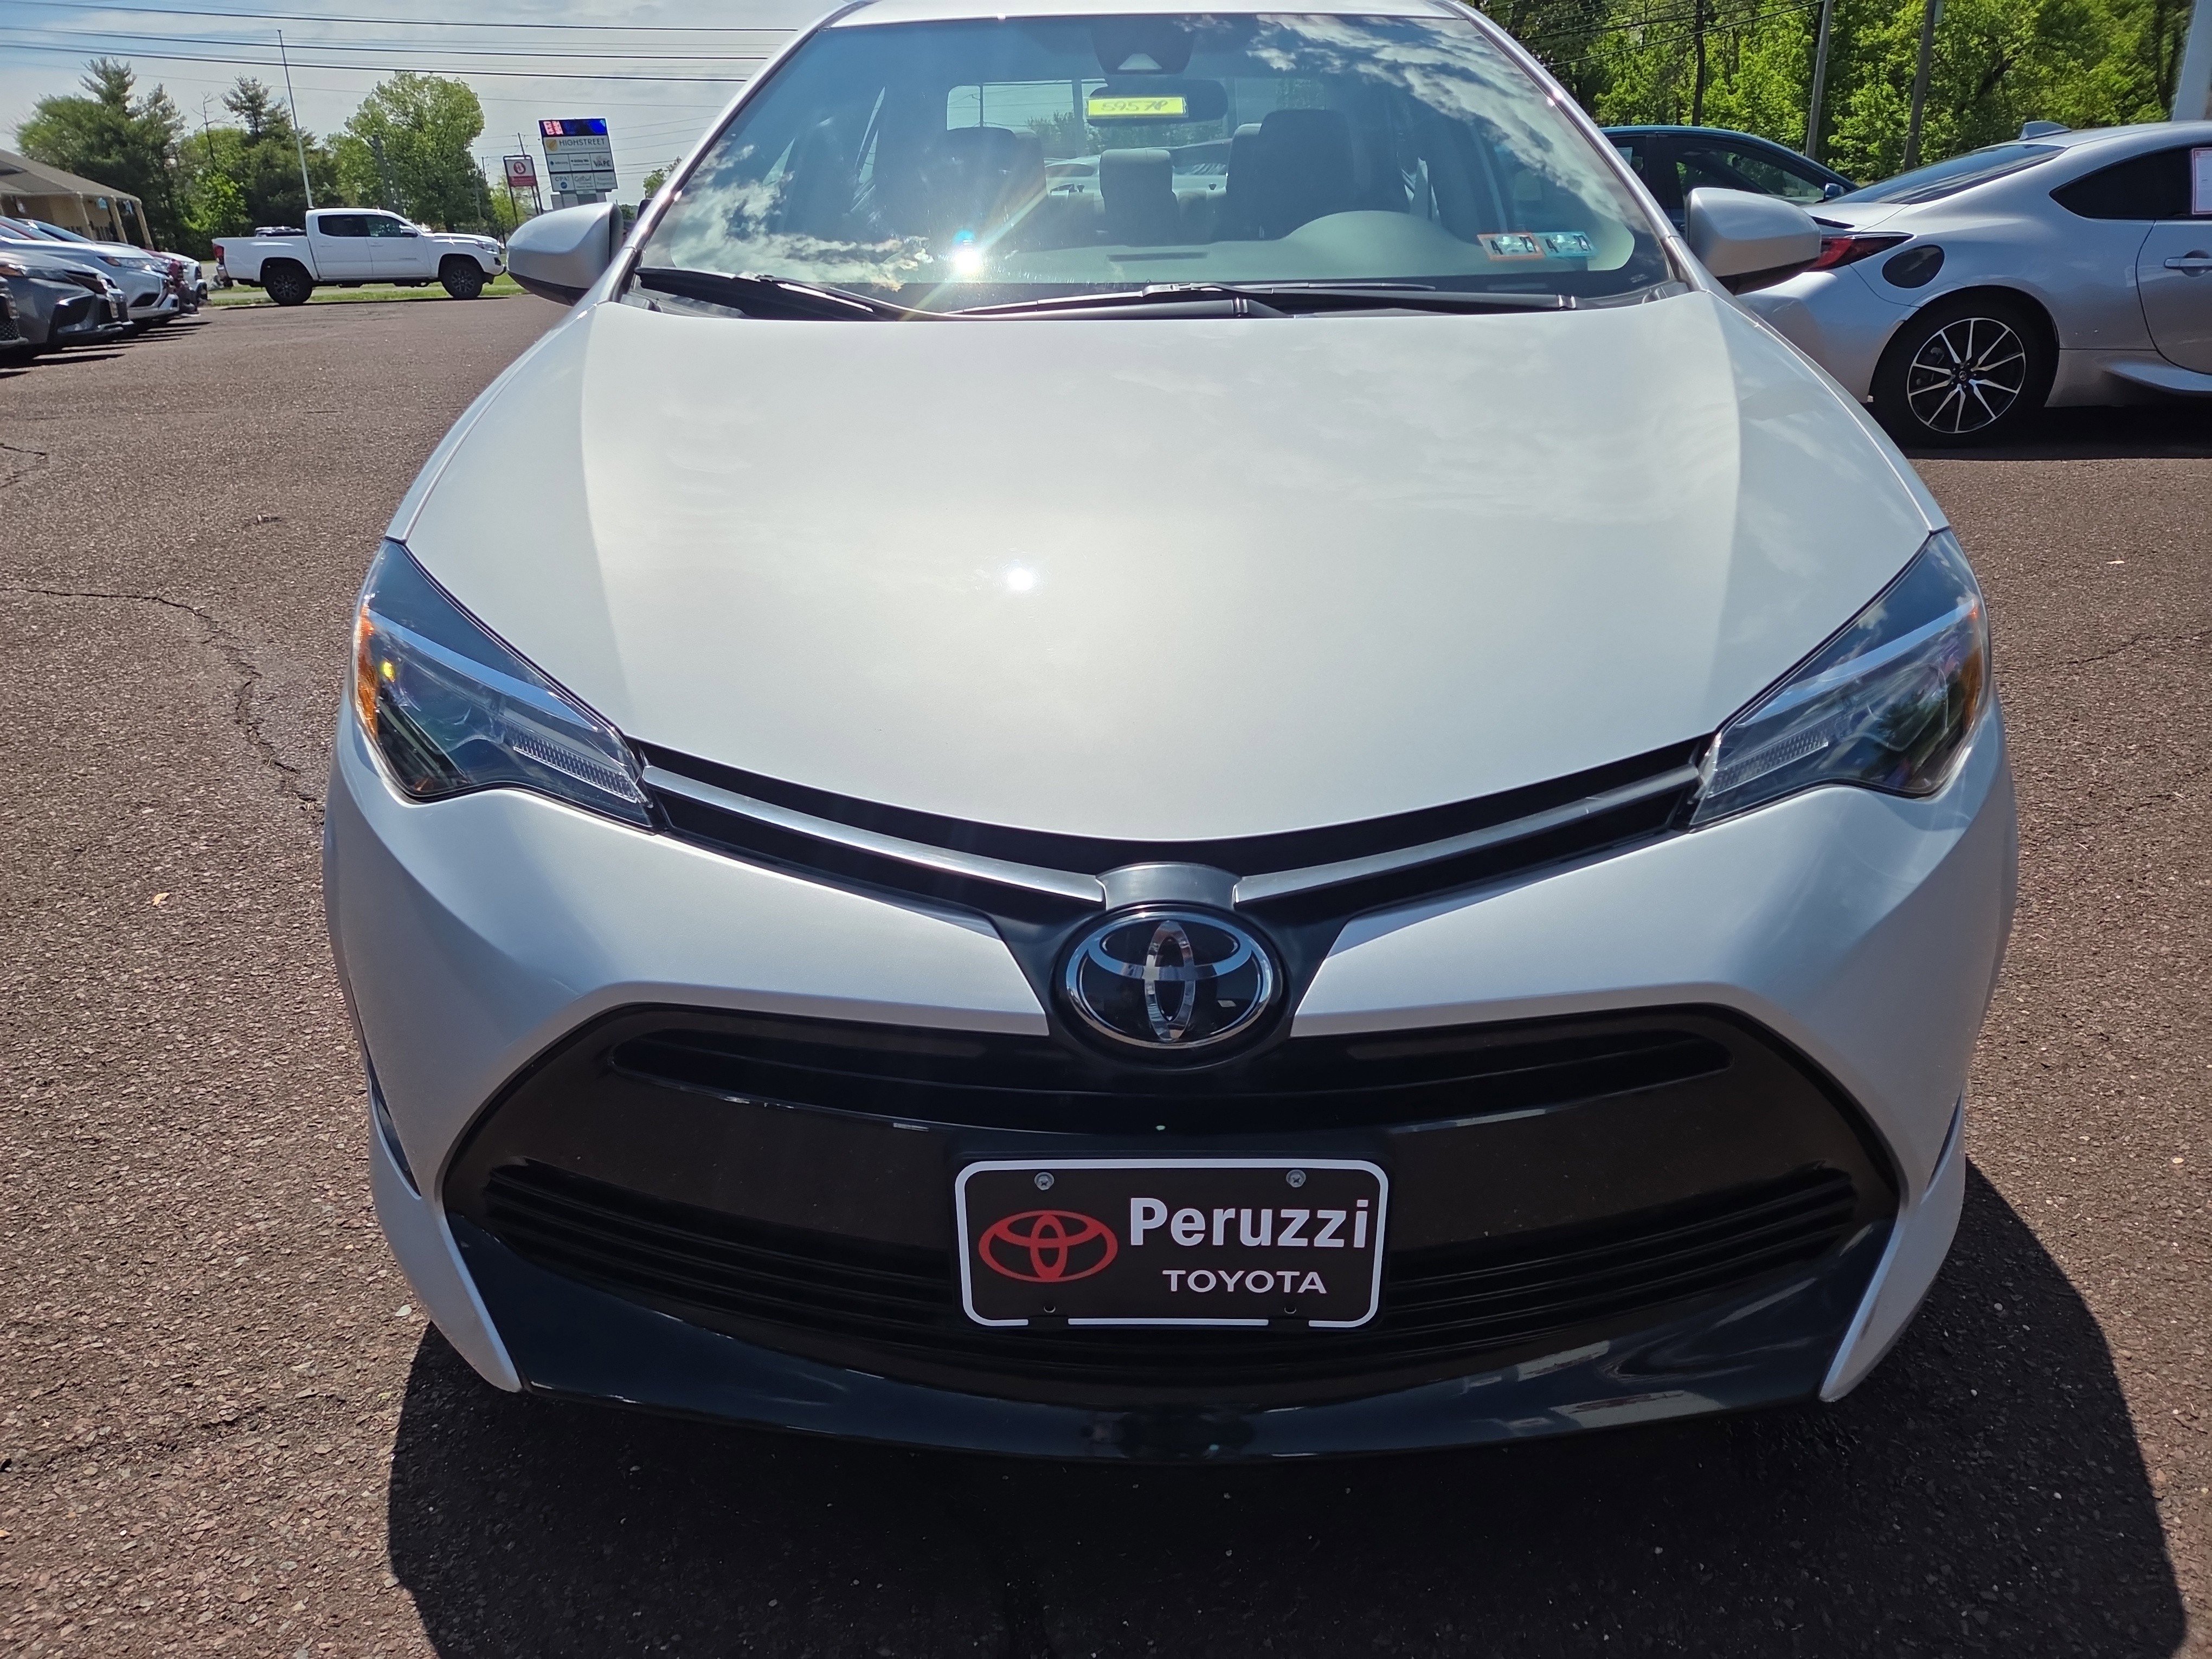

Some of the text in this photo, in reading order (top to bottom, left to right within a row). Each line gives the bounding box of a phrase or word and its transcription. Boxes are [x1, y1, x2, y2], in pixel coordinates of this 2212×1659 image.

[559, 138, 605, 146] HIGHSTREET
[1130, 1197, 1369, 1249] Peruzzi
[1162, 1269, 1328, 1294] TOYOTA
